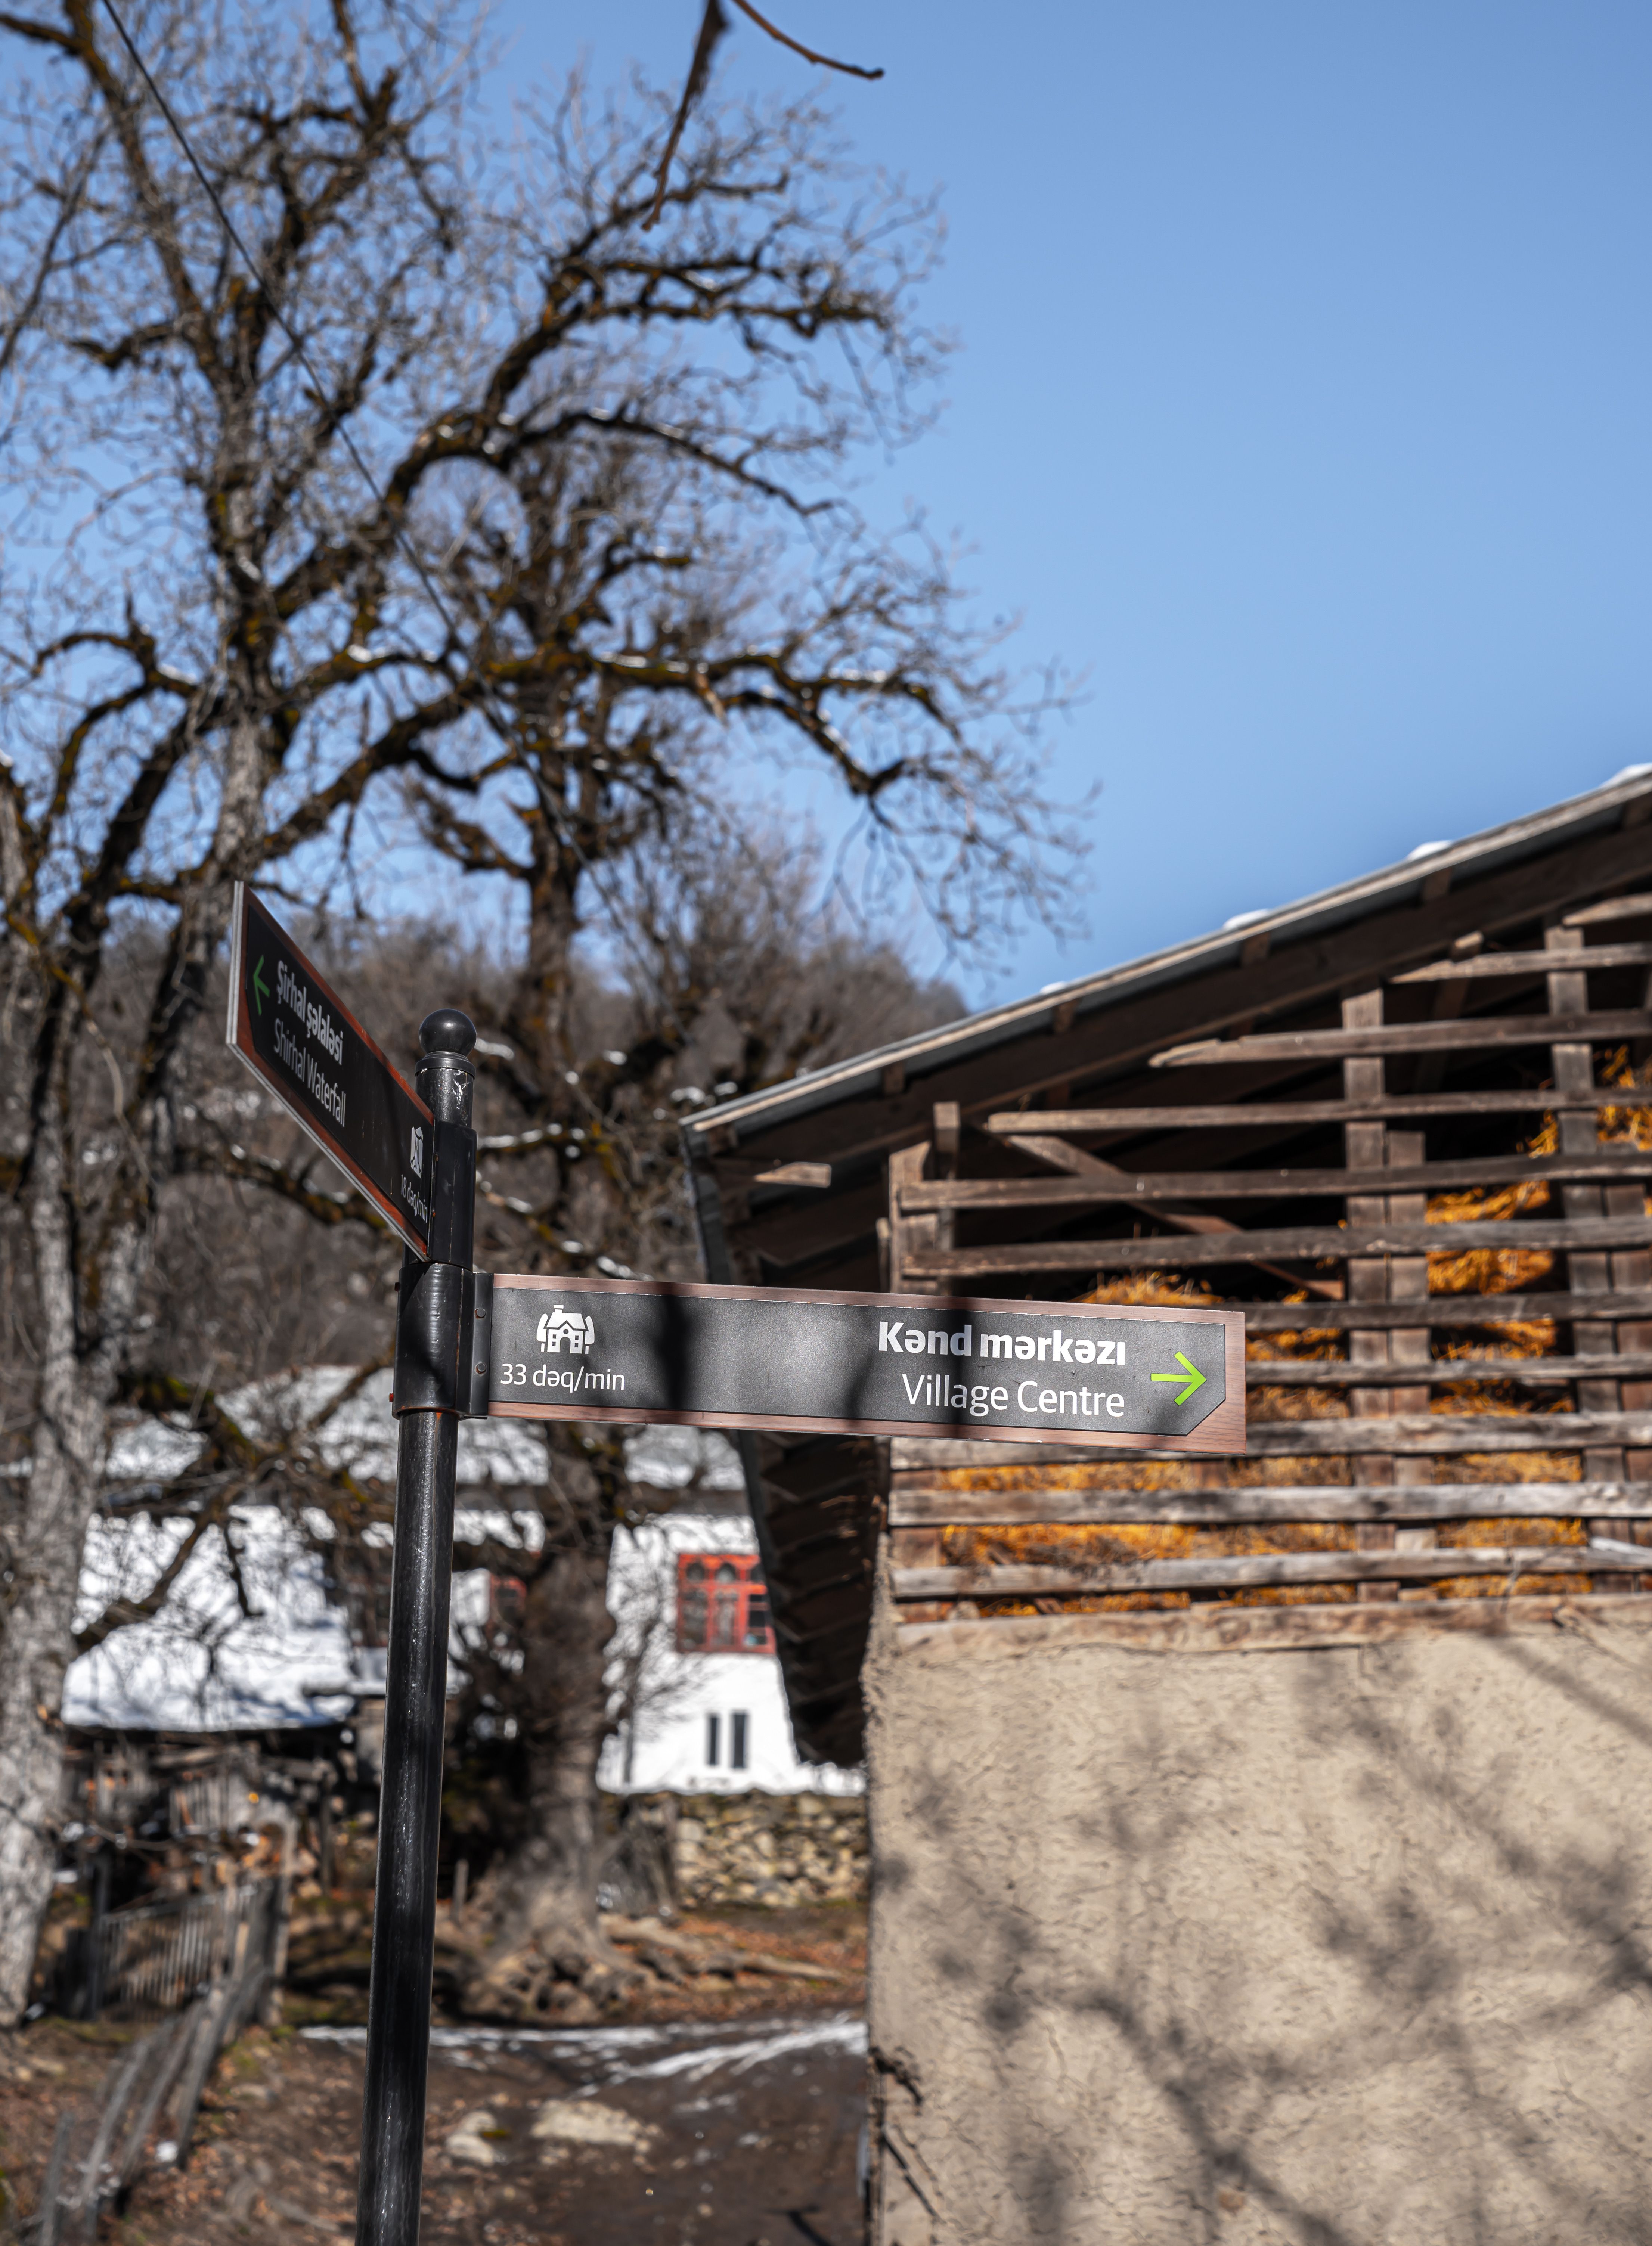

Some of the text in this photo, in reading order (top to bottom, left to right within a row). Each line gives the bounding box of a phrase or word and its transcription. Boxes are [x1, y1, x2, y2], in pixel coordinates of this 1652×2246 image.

[277, 960, 343, 1065] Şirhal şəlaləsi
[274, 1018, 346, 1127] Shirhal Waterfall
[401, 1174, 428, 1223] 18 dəq/min
[879, 1321, 972, 1356] Kənd
[500, 1363, 624, 1393] 33 dəq/min
[902, 1374, 1124, 1417] Village Centre
